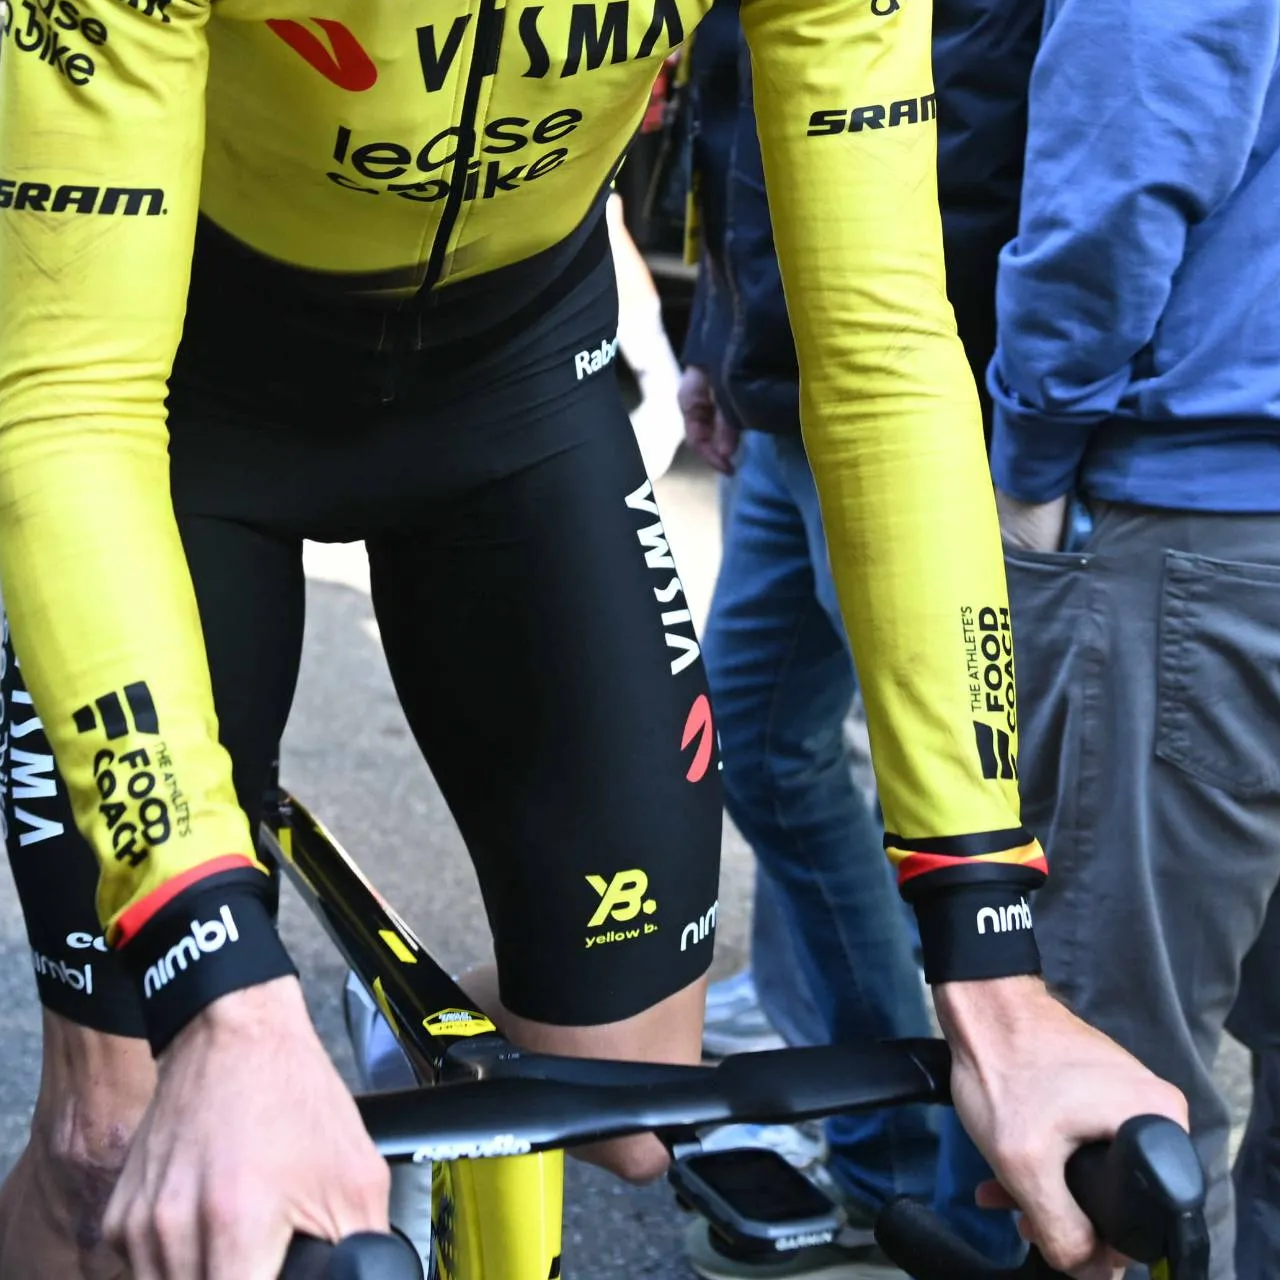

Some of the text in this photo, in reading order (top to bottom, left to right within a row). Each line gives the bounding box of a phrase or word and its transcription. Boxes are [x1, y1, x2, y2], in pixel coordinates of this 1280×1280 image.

[333, 108, 583, 180] lease
[624, 479, 701, 675] VISMA
[960, 606, 982, 712] THE ATHLETE'S
[978, 606, 1005, 713] FOOD
[999, 606, 1017, 734] COACH
[10, 656, 64, 847] ISMA
[118, 747, 171, 847] FOOD
[93, 748, 150, 868] COACH
[34, 951, 93, 995] imbl
[143, 904, 240, 999] nimbl
[585, 928, 640, 949] yellow
